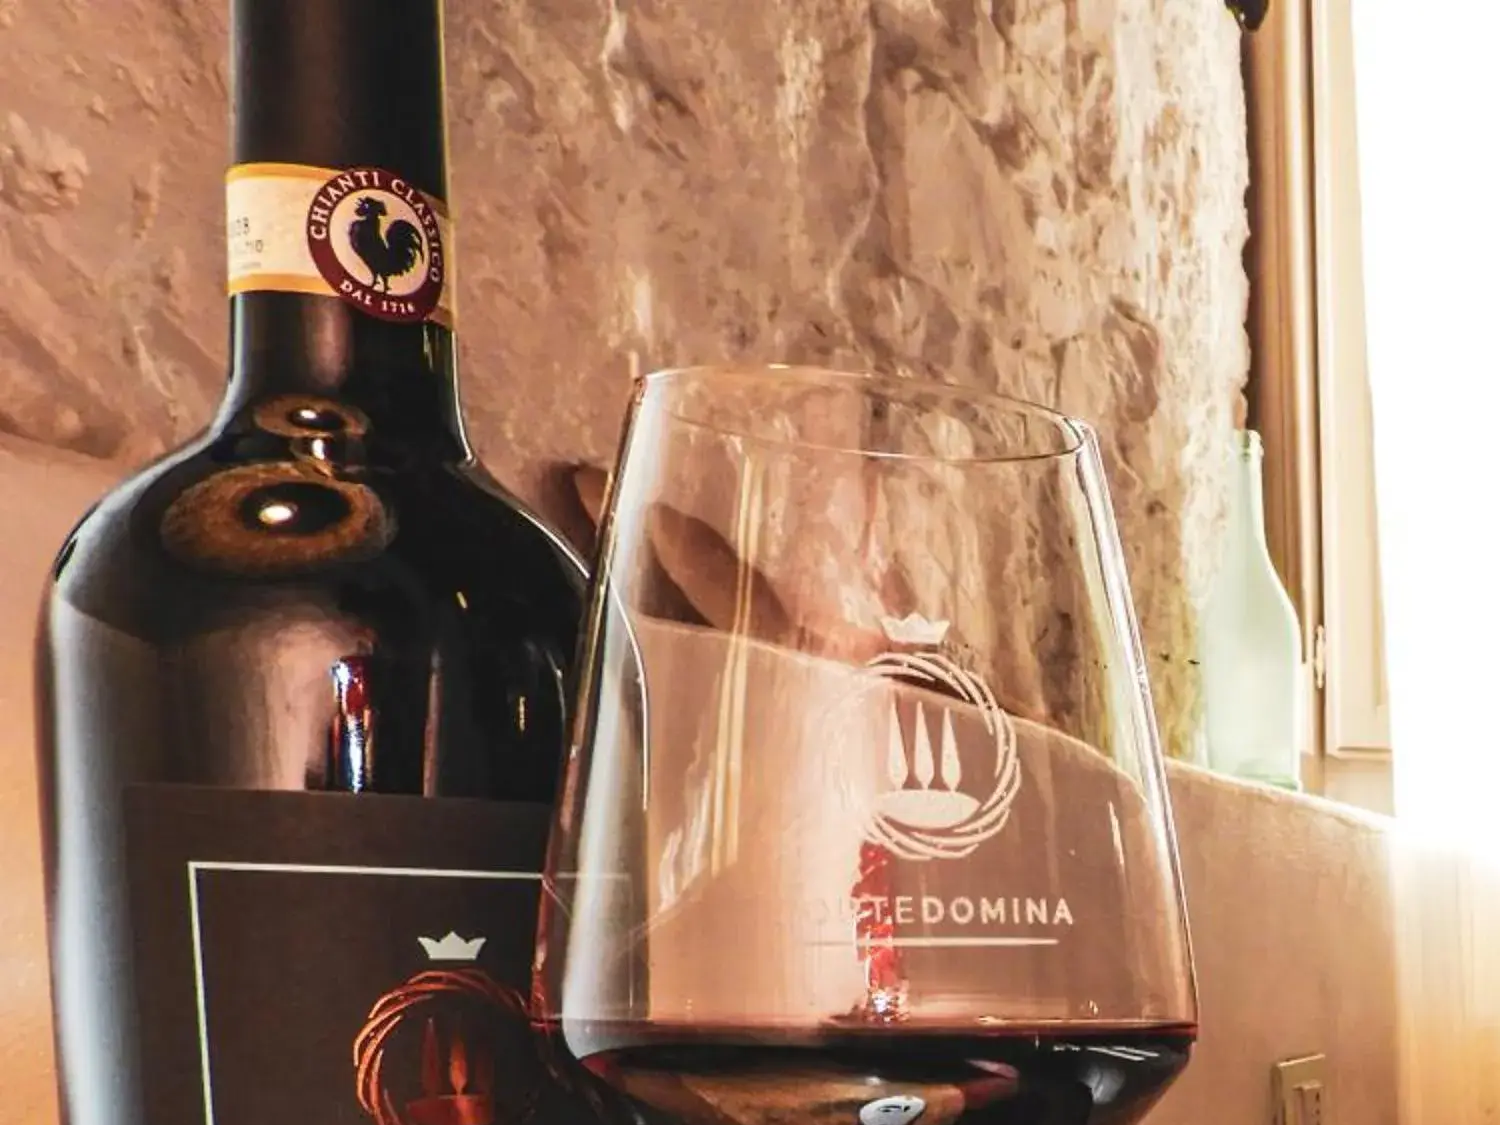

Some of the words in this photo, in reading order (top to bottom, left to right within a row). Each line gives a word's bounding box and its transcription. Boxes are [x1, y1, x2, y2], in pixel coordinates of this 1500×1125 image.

[310, 170, 380, 240] CHIANTI
[390, 178, 442, 283] CLASSICO
[339, 281, 372, 306] DAL
